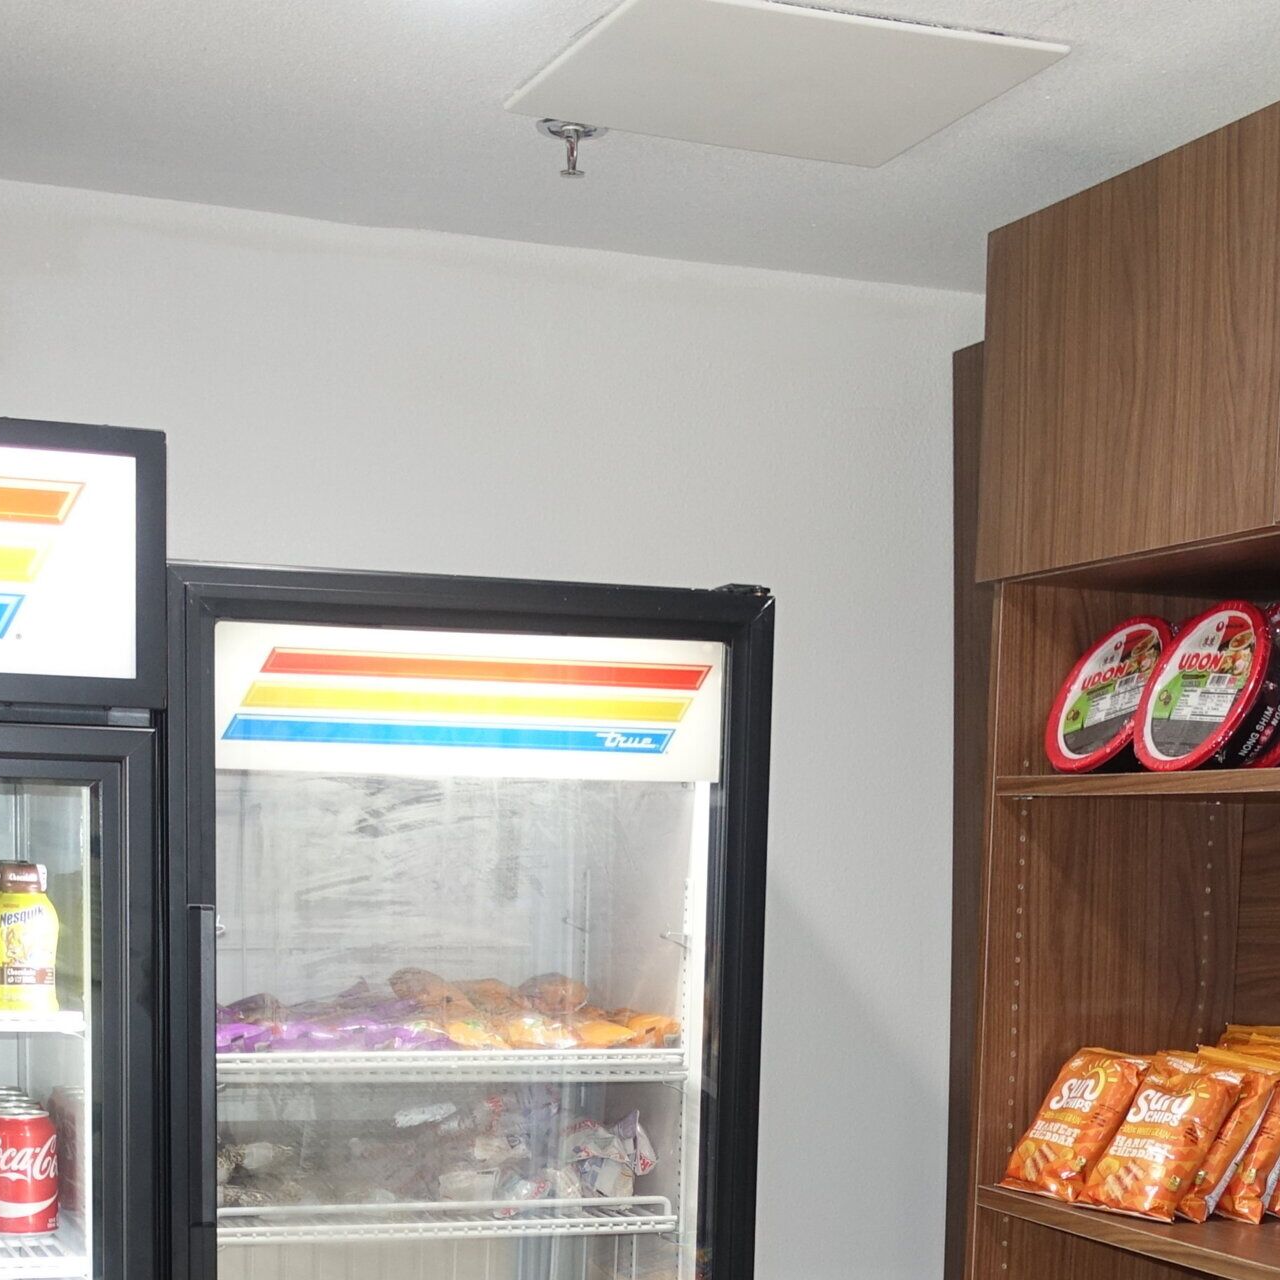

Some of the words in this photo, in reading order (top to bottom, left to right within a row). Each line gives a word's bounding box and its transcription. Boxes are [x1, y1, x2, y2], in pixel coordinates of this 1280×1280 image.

[1178, 652, 1225, 672] UDON
[1081, 661, 1129, 690] UDON
[1238, 732, 1260, 757] NONG
[1256, 705, 1275, 732] SHIM
[0, 906, 44, 929] Nesquik
[1063, 1097, 1093, 1113] CHIPS
[1035, 1120, 1081, 1138] HARVEST
[1145, 1111, 1183, 1127] CHIPS
